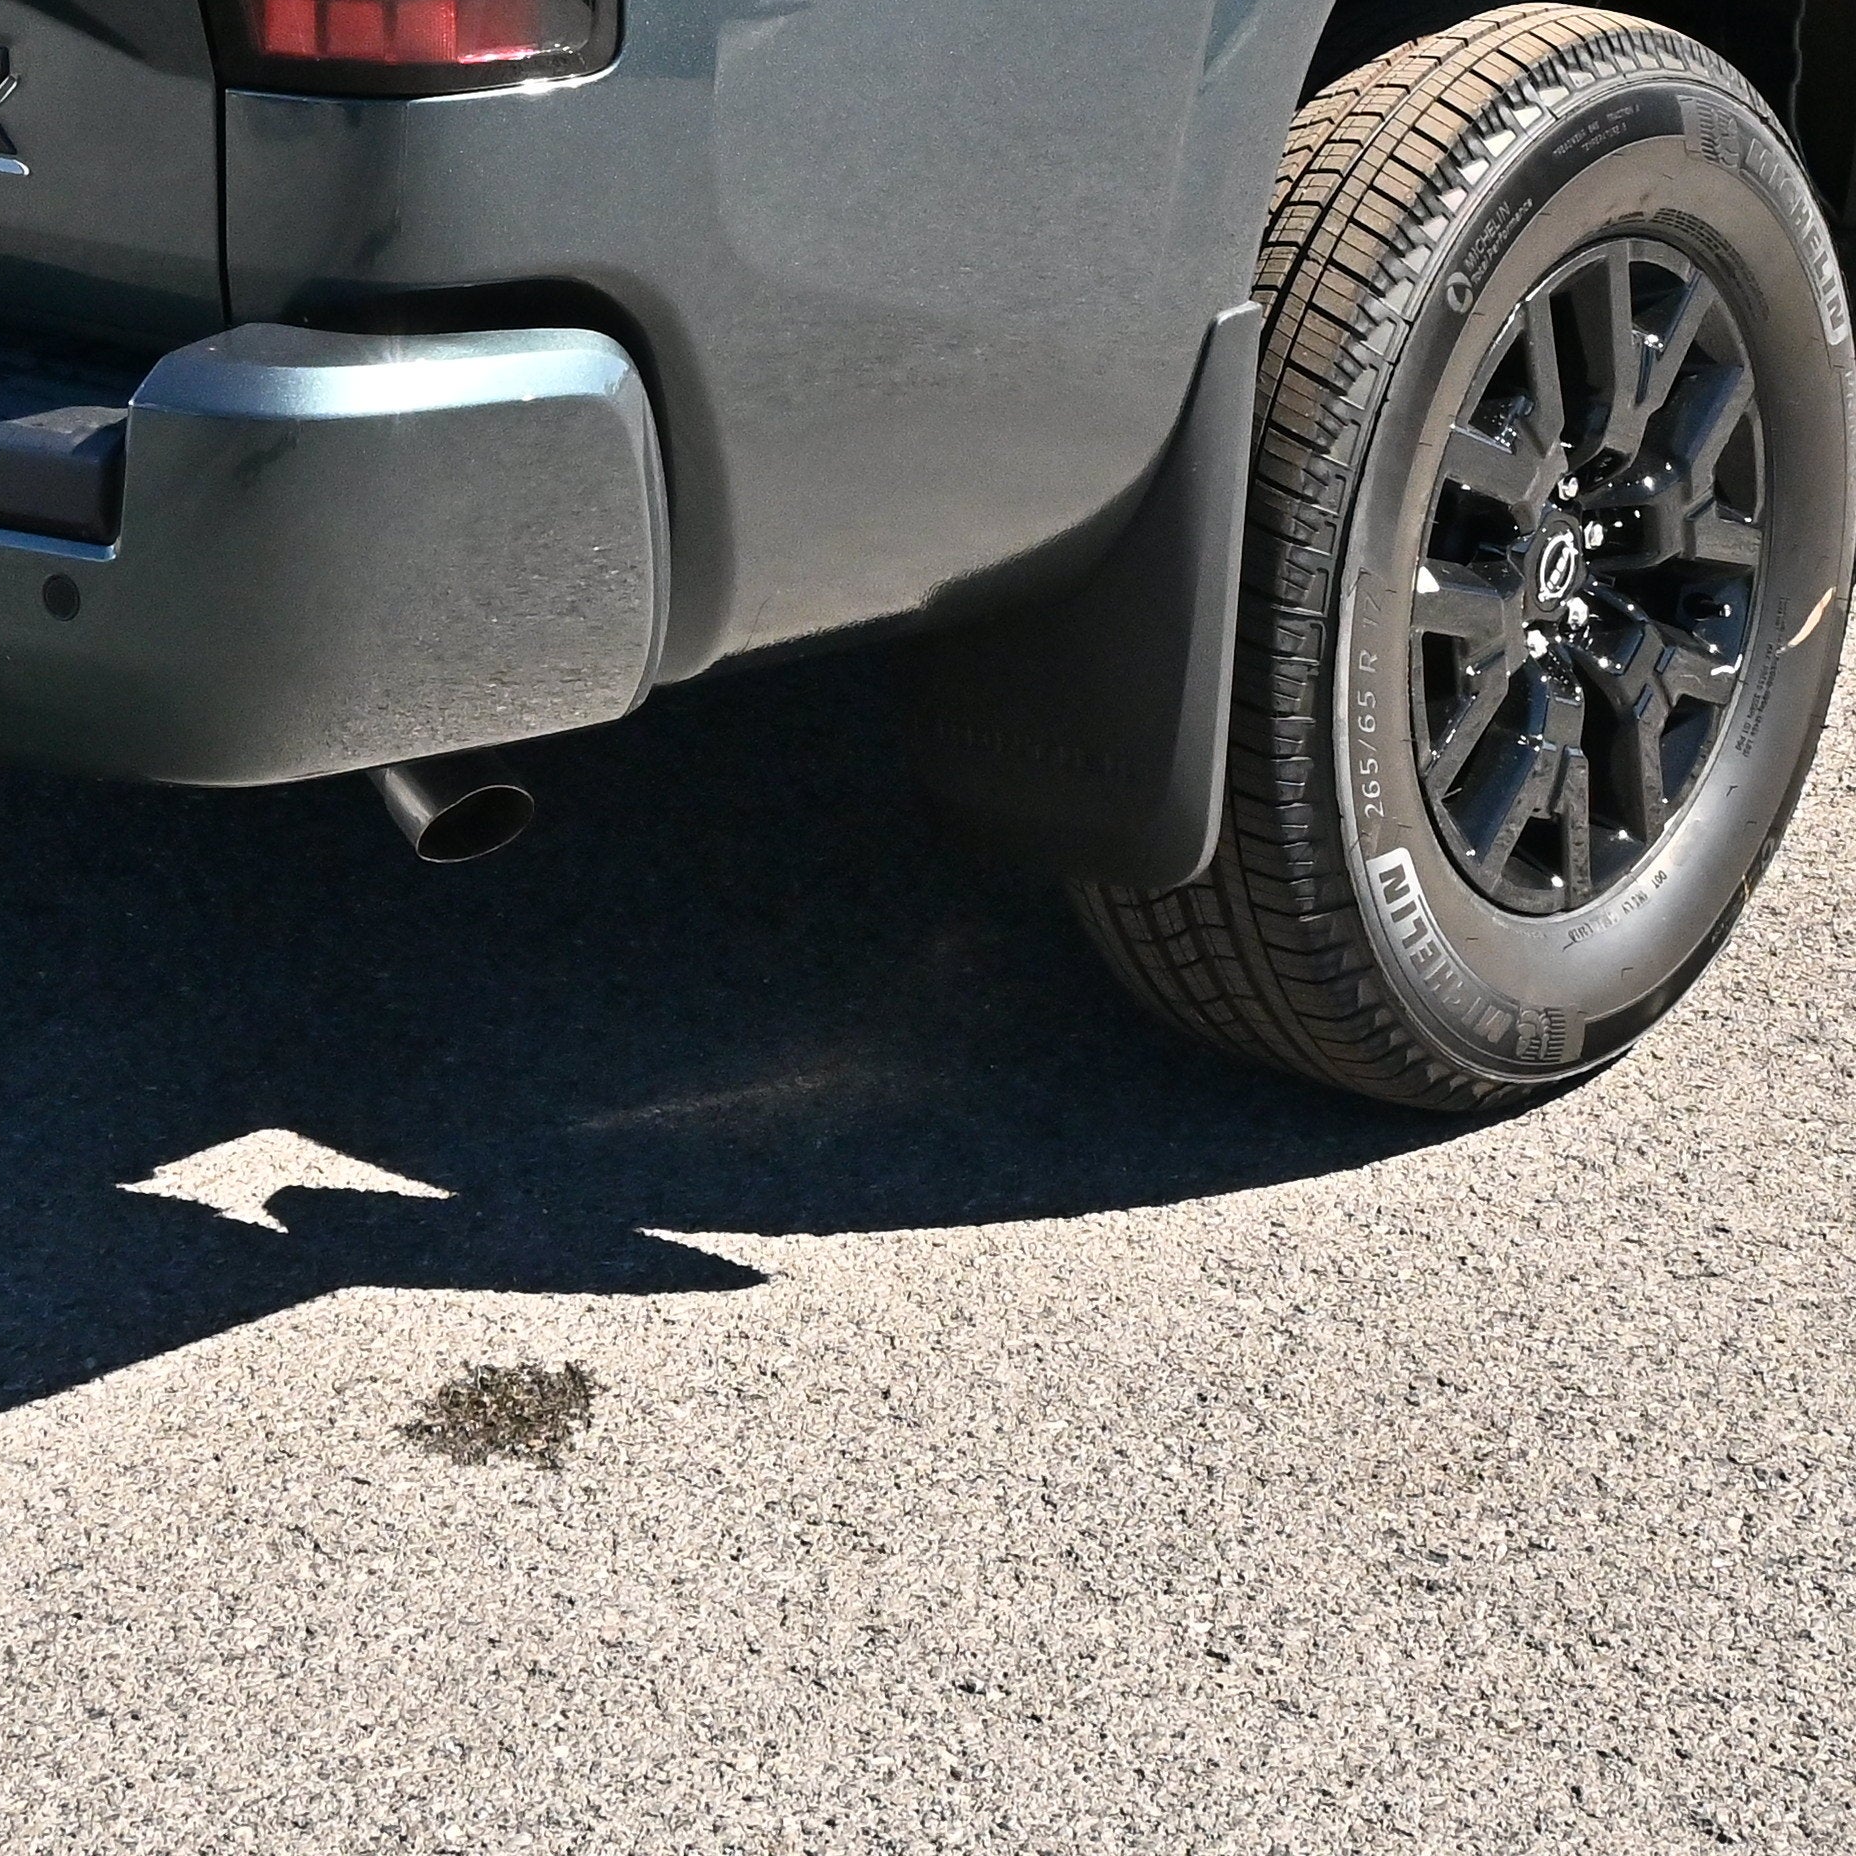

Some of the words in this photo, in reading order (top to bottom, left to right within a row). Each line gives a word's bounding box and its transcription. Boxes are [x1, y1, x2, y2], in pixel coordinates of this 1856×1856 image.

[1462, 200, 1513, 273] MICHELIN
[1745, 138, 1846, 332] MICHELIN
[1358, 648, 1378, 673] R
[1357, 690, 1385, 821] 265/65
[1378, 863, 1513, 1045] MICHELIN
